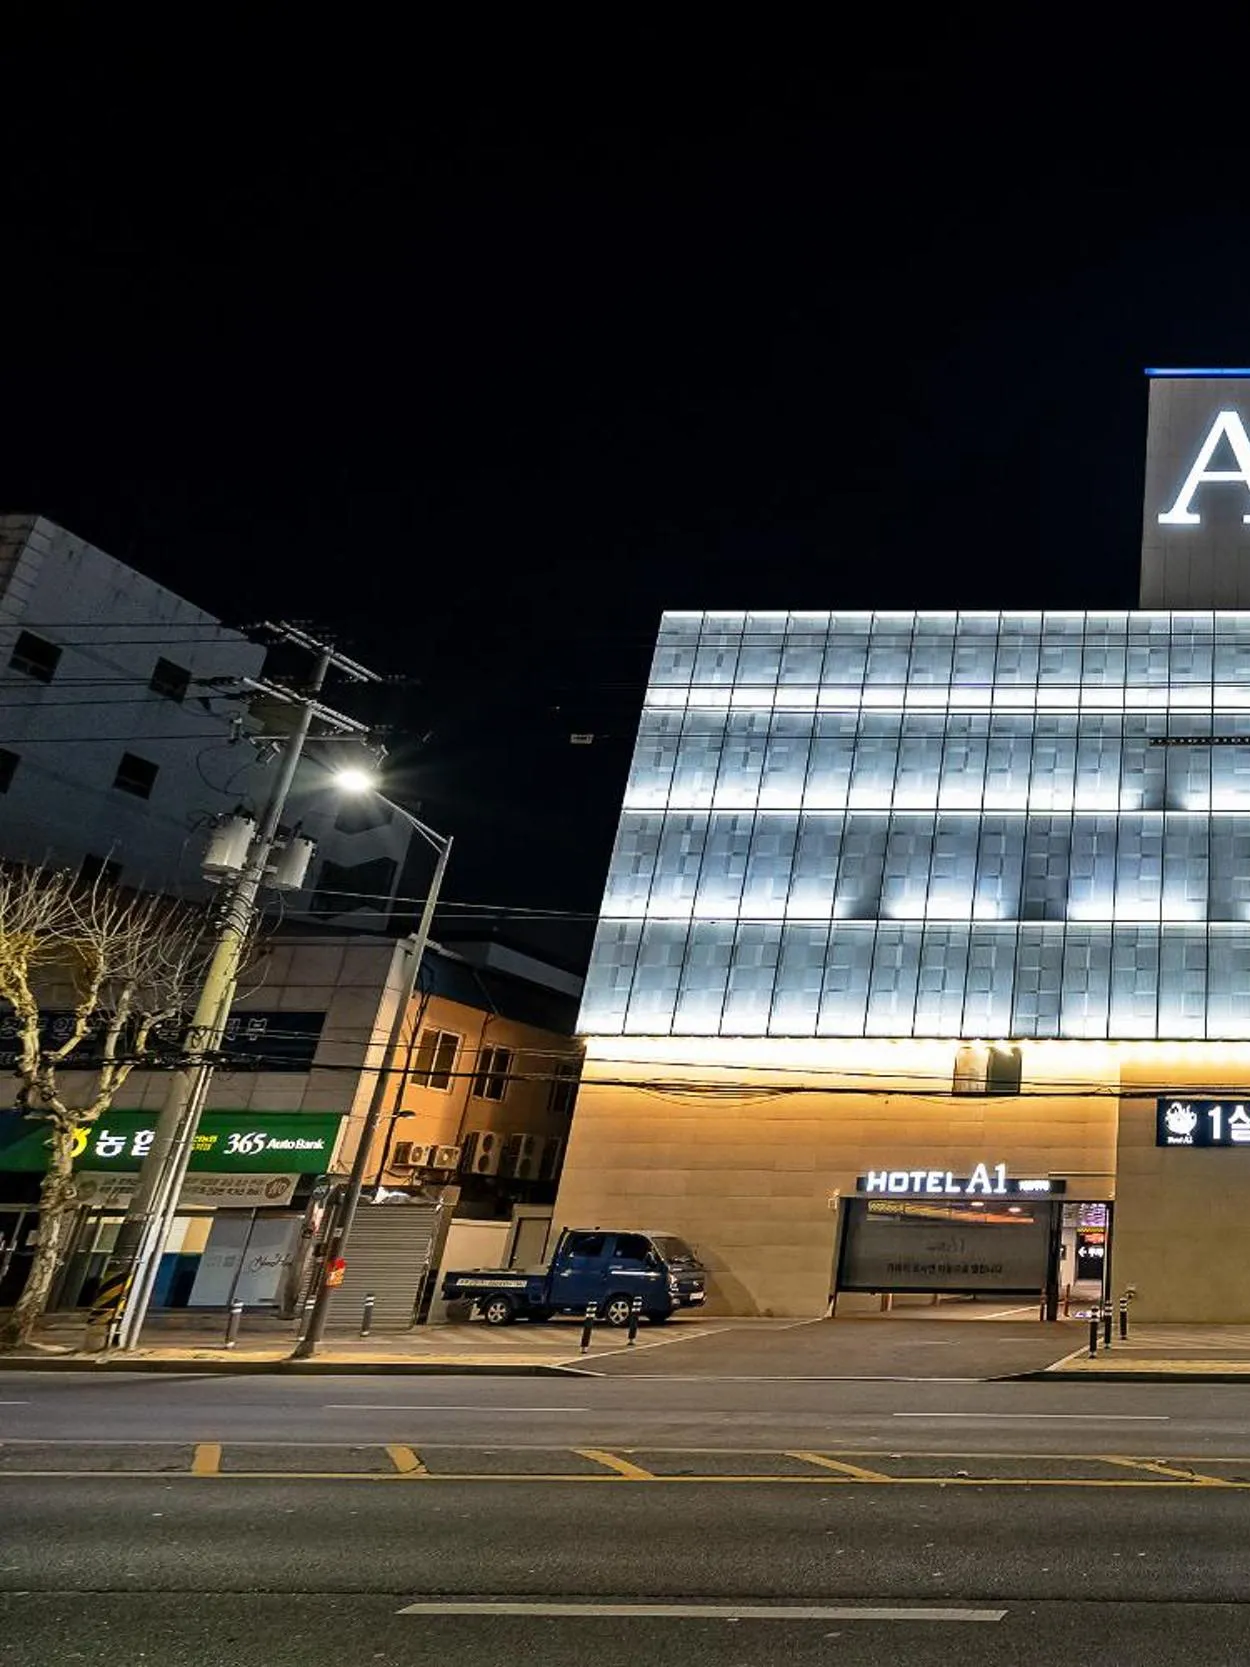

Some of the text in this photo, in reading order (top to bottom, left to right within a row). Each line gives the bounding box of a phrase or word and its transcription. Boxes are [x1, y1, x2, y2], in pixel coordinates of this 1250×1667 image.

[223, 1132, 267, 1155] 365
[866, 1162, 1008, 1194] HOTEL A1
